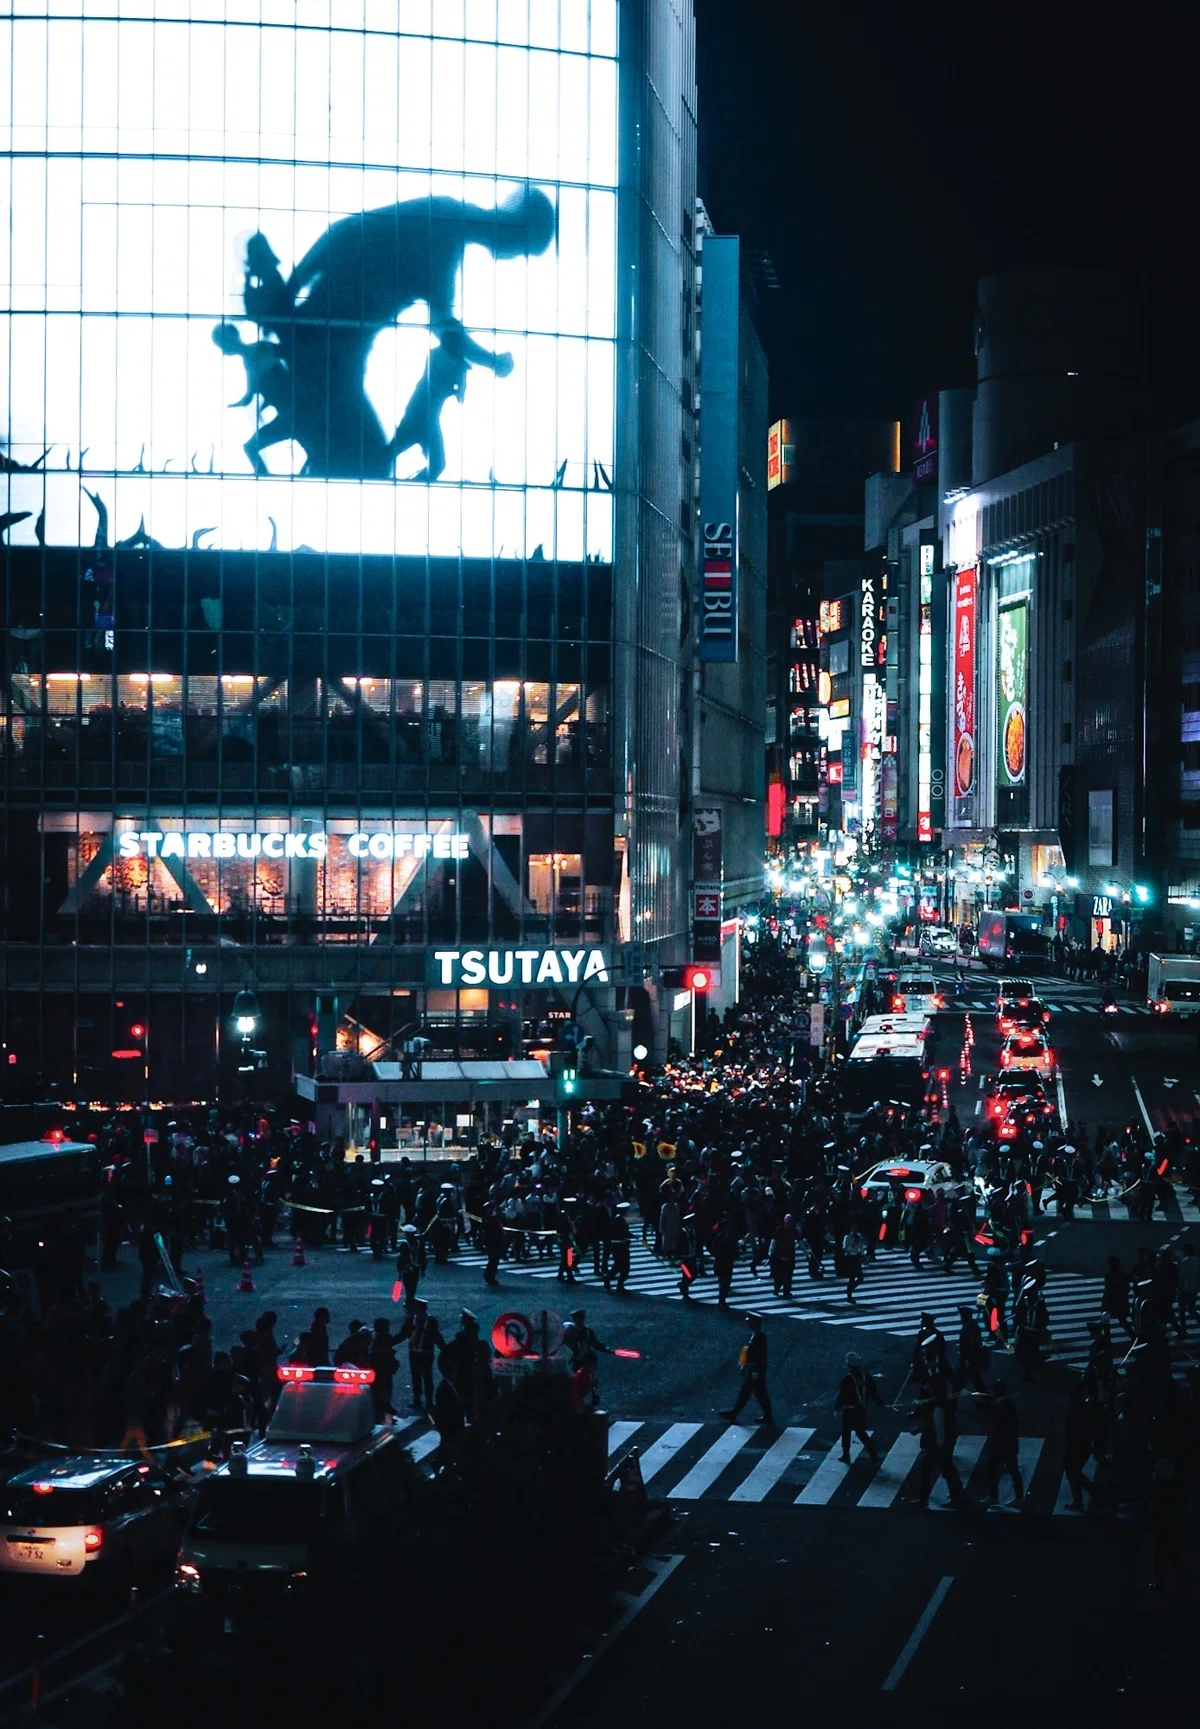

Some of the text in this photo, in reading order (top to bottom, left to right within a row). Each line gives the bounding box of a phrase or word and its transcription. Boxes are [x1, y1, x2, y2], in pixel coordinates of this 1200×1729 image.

[703, 522, 732, 634] SEIBU
[861, 578, 875, 667] KARAOKE
[118, 831, 471, 860] STARBUCKS COFFEE
[698, 896, 717, 915] 本
[1093, 896, 1113, 916] ZARA
[434, 949, 609, 984] TSUTAYA
[548, 1011, 571, 1019] STAR
